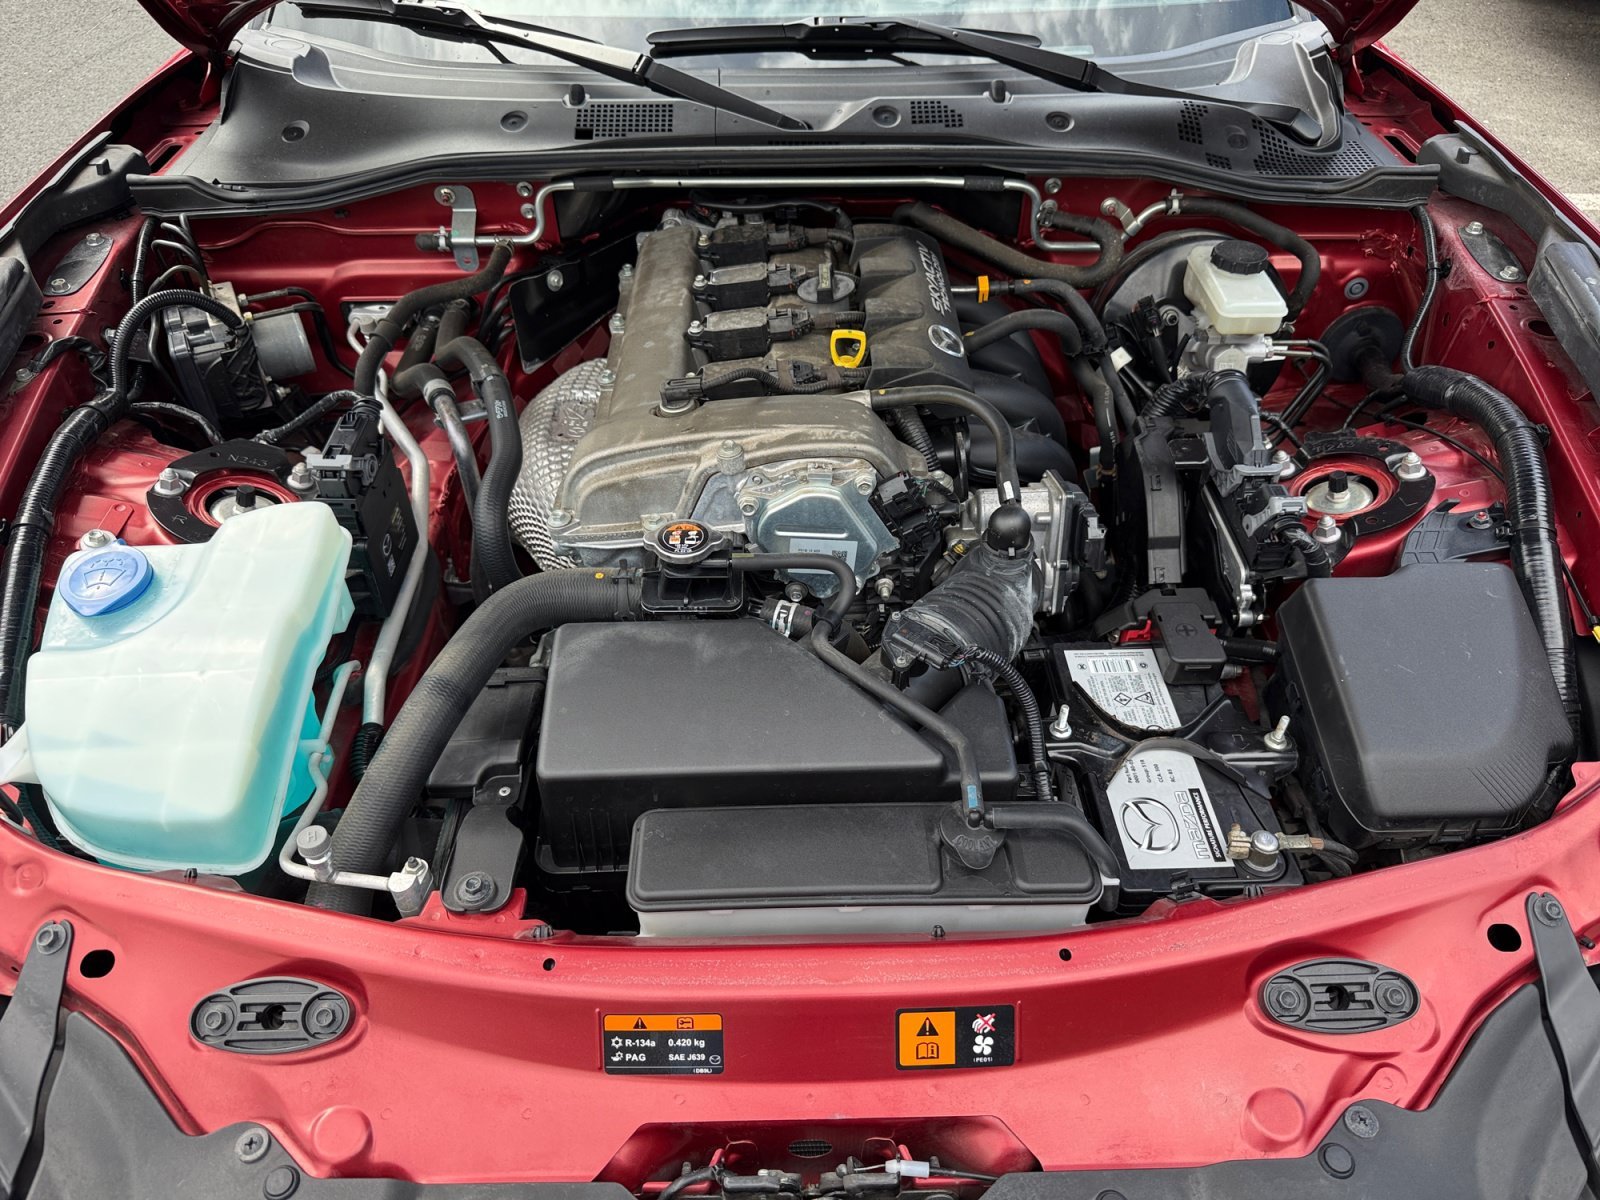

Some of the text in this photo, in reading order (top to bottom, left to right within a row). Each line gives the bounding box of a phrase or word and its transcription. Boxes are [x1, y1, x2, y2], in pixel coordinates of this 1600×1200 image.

[916, 240, 945, 316] SKYACTIV
[955, 835, 997, 851] COOLANT
[625, 1038, 706, 1048] R-134a 0.420 kg
[625, 1053, 706, 1062] PAG SAE J639
